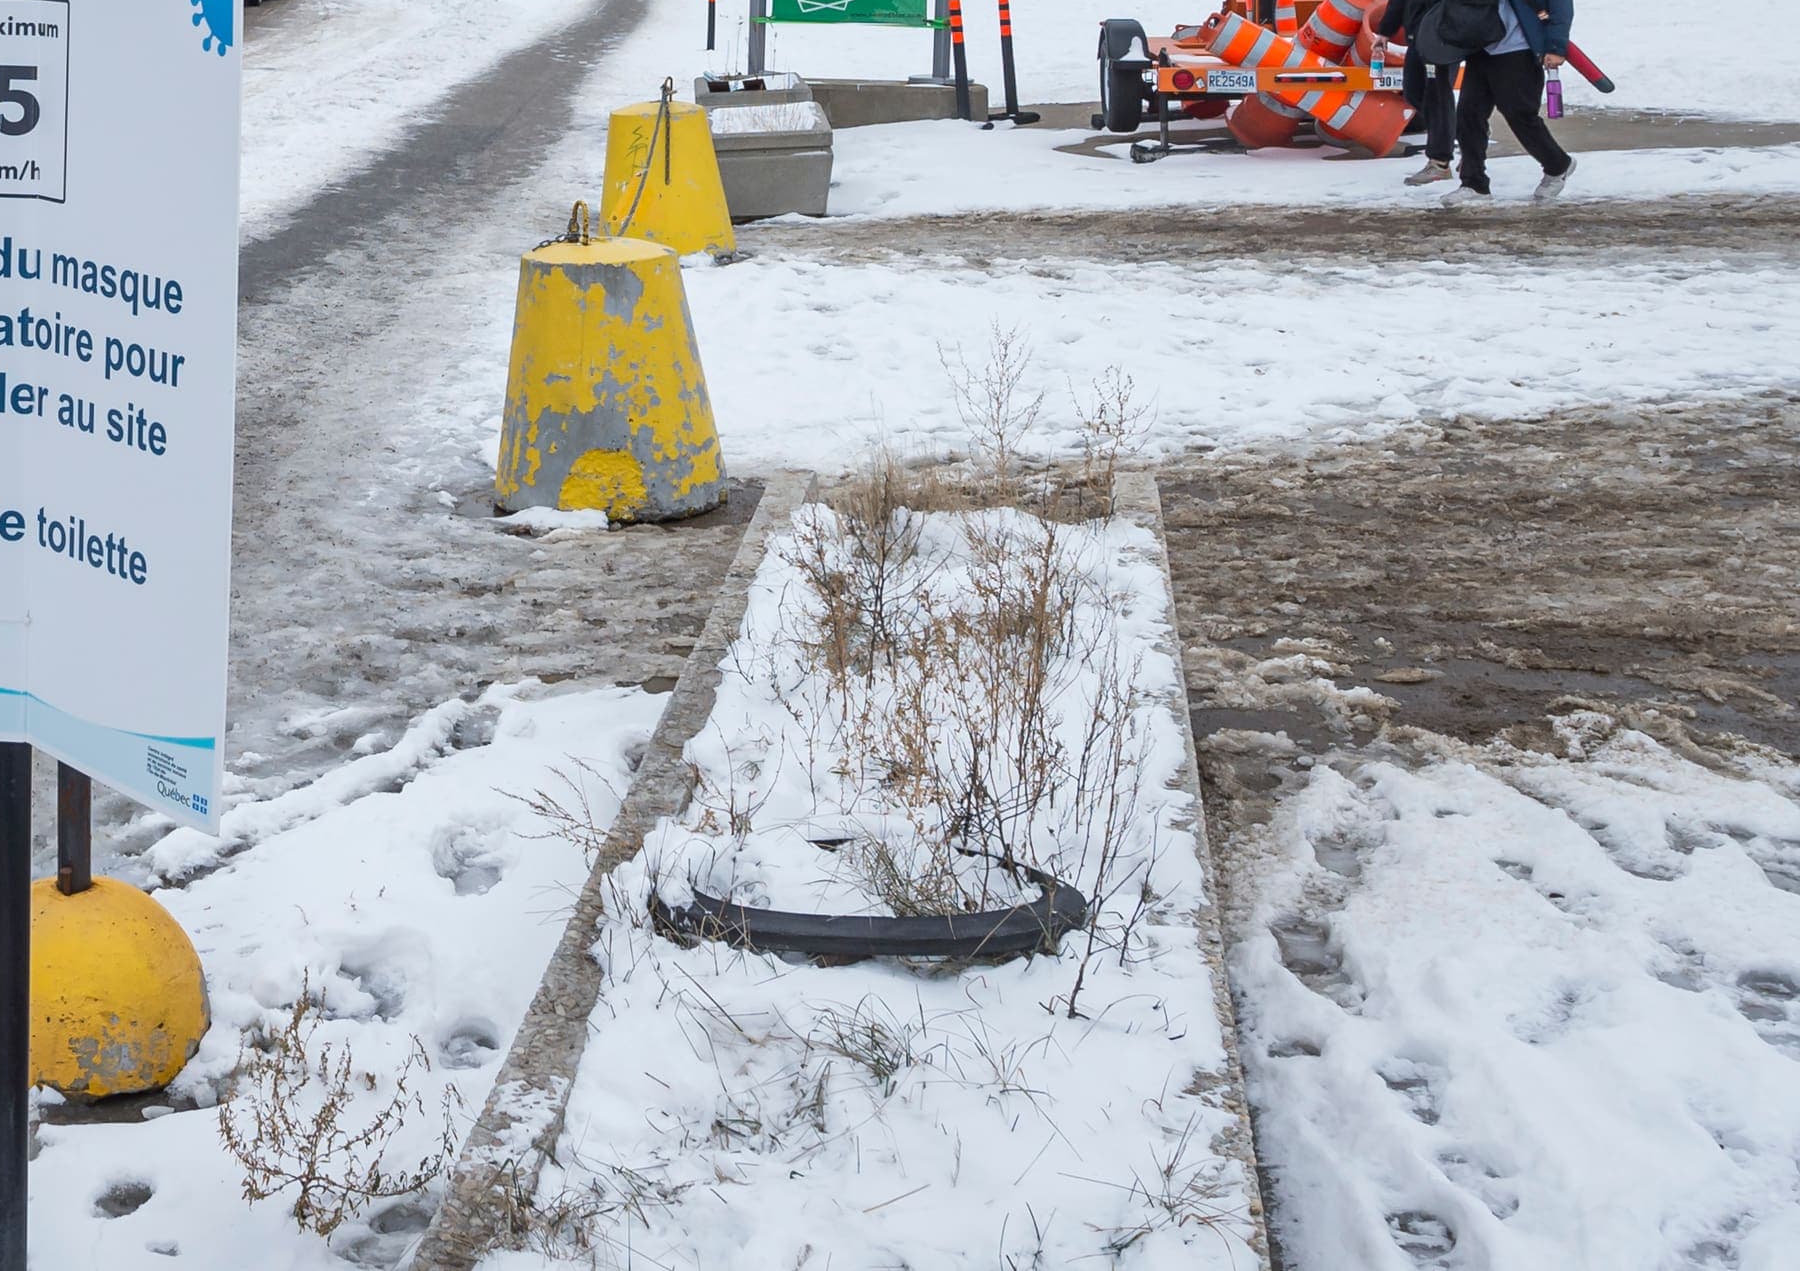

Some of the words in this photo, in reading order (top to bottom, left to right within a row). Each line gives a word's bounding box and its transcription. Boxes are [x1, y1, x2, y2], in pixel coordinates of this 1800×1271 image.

[1209, 74, 1256, 87] RE2549A
[52, 252, 184, 316] masque
[105, 335, 186, 388] pour
[57, 393, 95, 434] au
[106, 403, 168, 457] site
[37, 506, 148, 585] toilette
[157, 780, 191, 808] Québec
